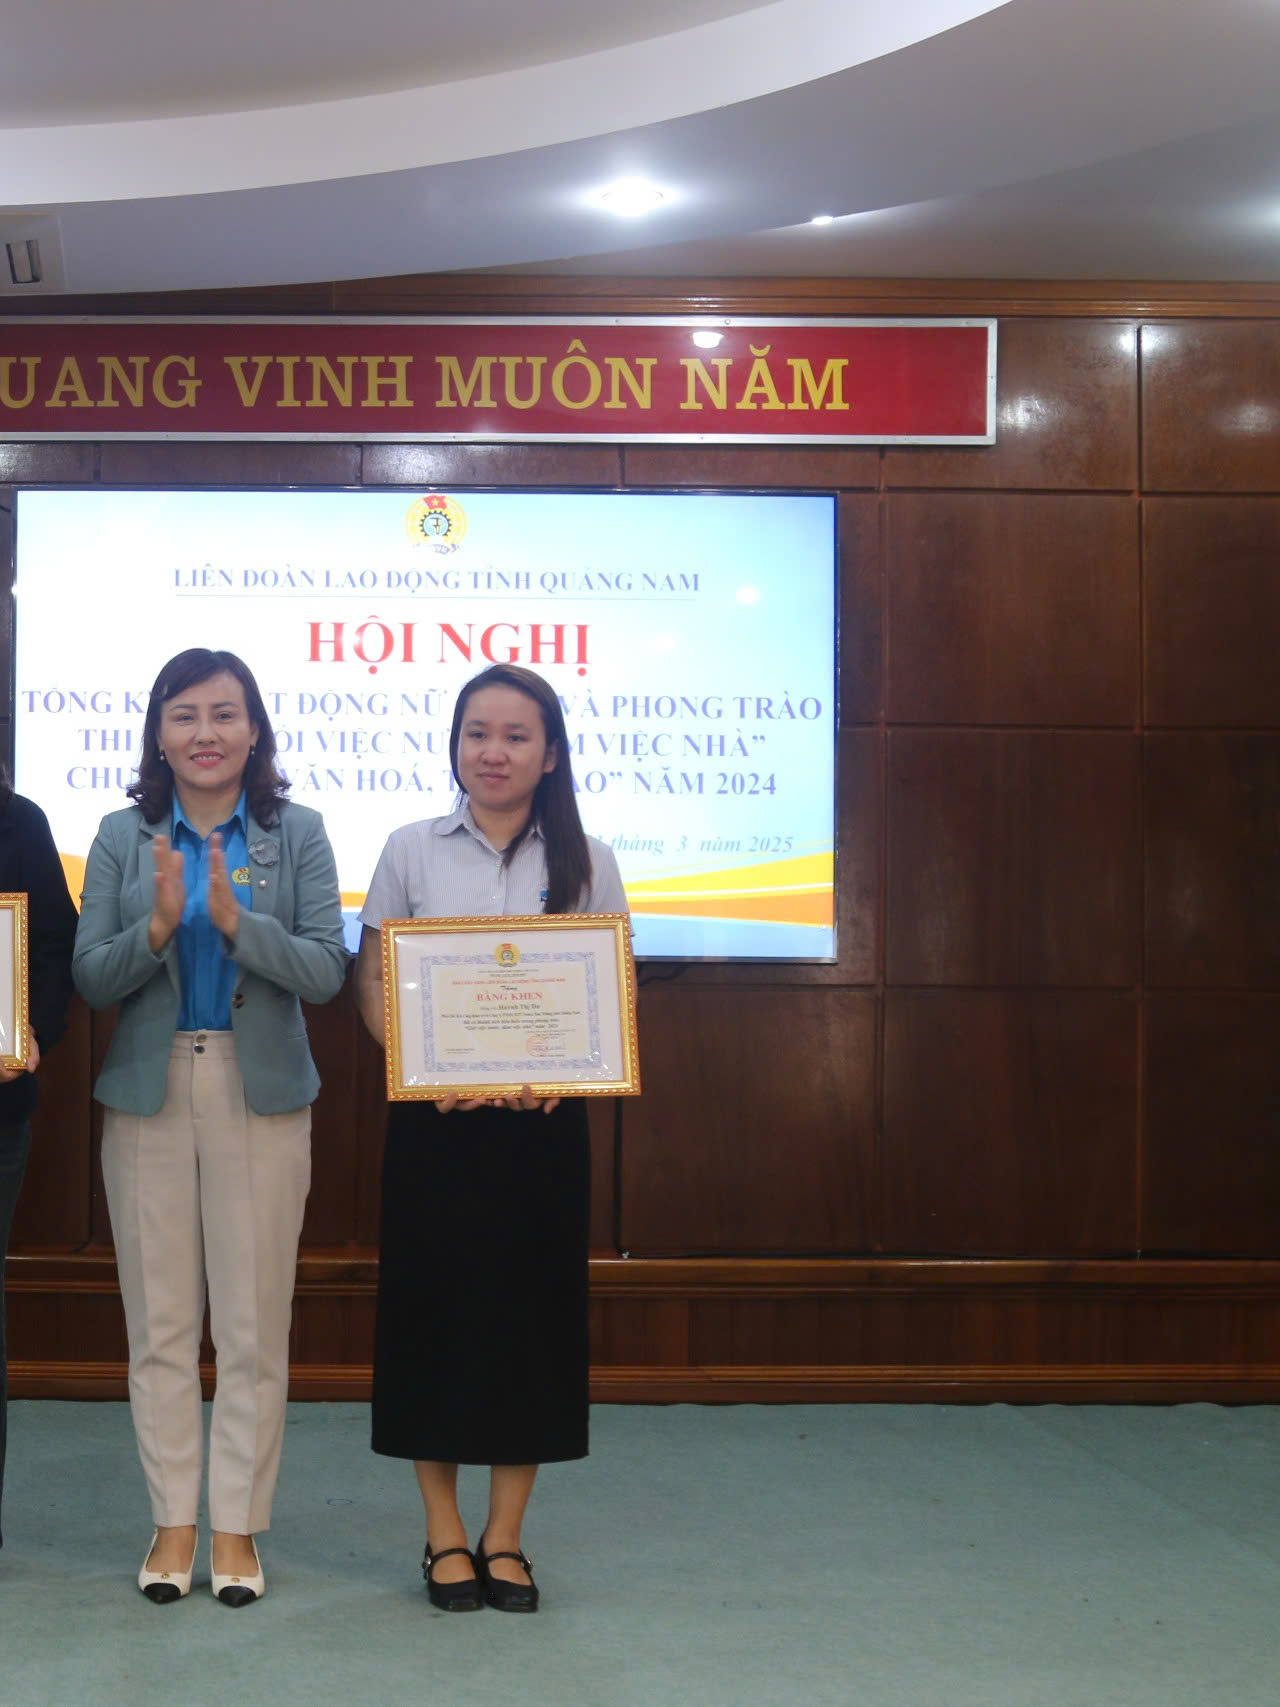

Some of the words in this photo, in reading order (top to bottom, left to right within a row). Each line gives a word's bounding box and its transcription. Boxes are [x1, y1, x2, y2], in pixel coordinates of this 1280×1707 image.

[223, 356, 414, 408] VINH
[435, 339, 658, 409] MUÔN
[679, 344, 850, 411] NĂM
[174, 562, 234, 588] LIÊN
[324, 569, 378, 589] LAO
[641, 572, 701, 592] NAM
[306, 614, 418, 675] HỘI
[435, 622, 592, 677] NGHỊ
[612, 695, 724, 720] PHONG
[732, 689, 823, 721] TRÀO
[77, 728, 133, 752] THI
[315, 727, 393, 760] VIỆC
[595, 730, 674, 763] VIỆC
[632, 765, 705, 795] NĂM
[716, 772, 777, 796] 2024
[746, 835, 794, 854] 2025
